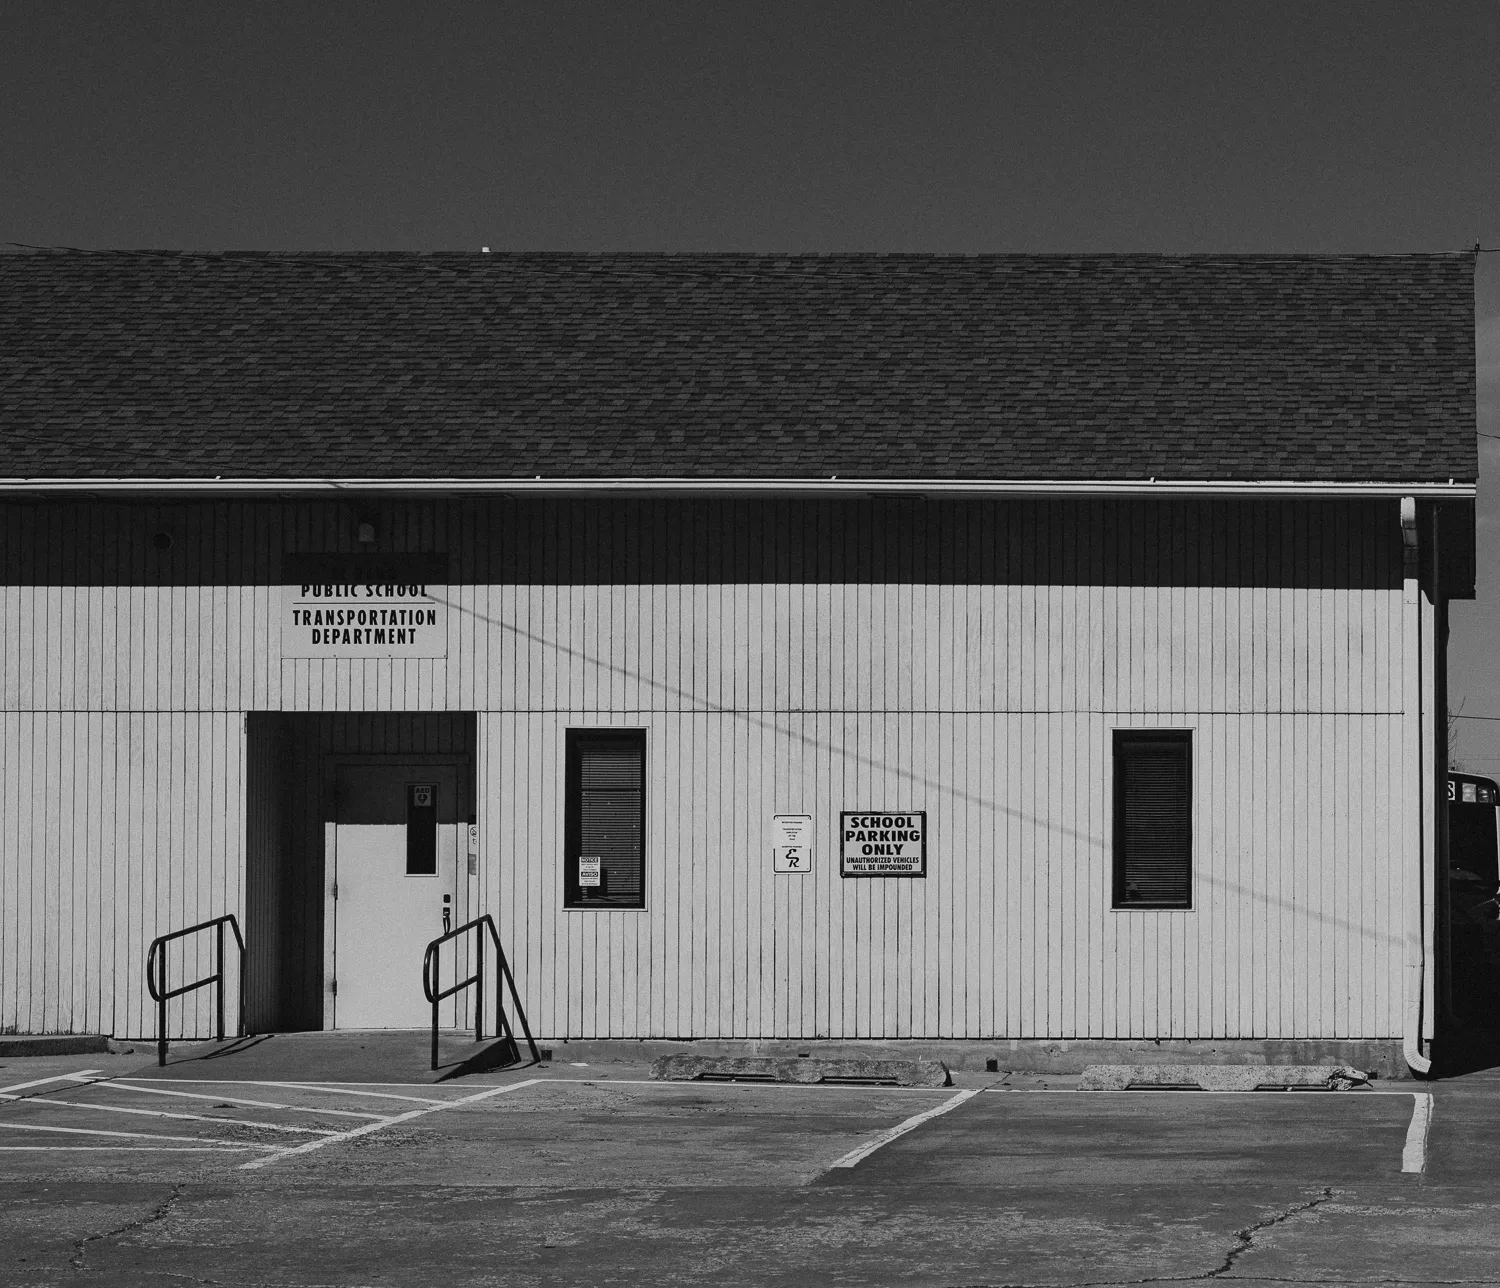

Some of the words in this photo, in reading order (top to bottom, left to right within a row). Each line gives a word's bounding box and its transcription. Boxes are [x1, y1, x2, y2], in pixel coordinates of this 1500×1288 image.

[301, 584, 358, 598] PUBLIC
[366, 584, 427, 598] SCHOOL
[293, 610, 436, 626] TRANSPORTATION
[312, 629, 416, 645] DEPARTMENT
[851, 817, 914, 828] SCHOOL
[845, 830, 920, 842] PARKING
[862, 844, 904, 855] ONLY
